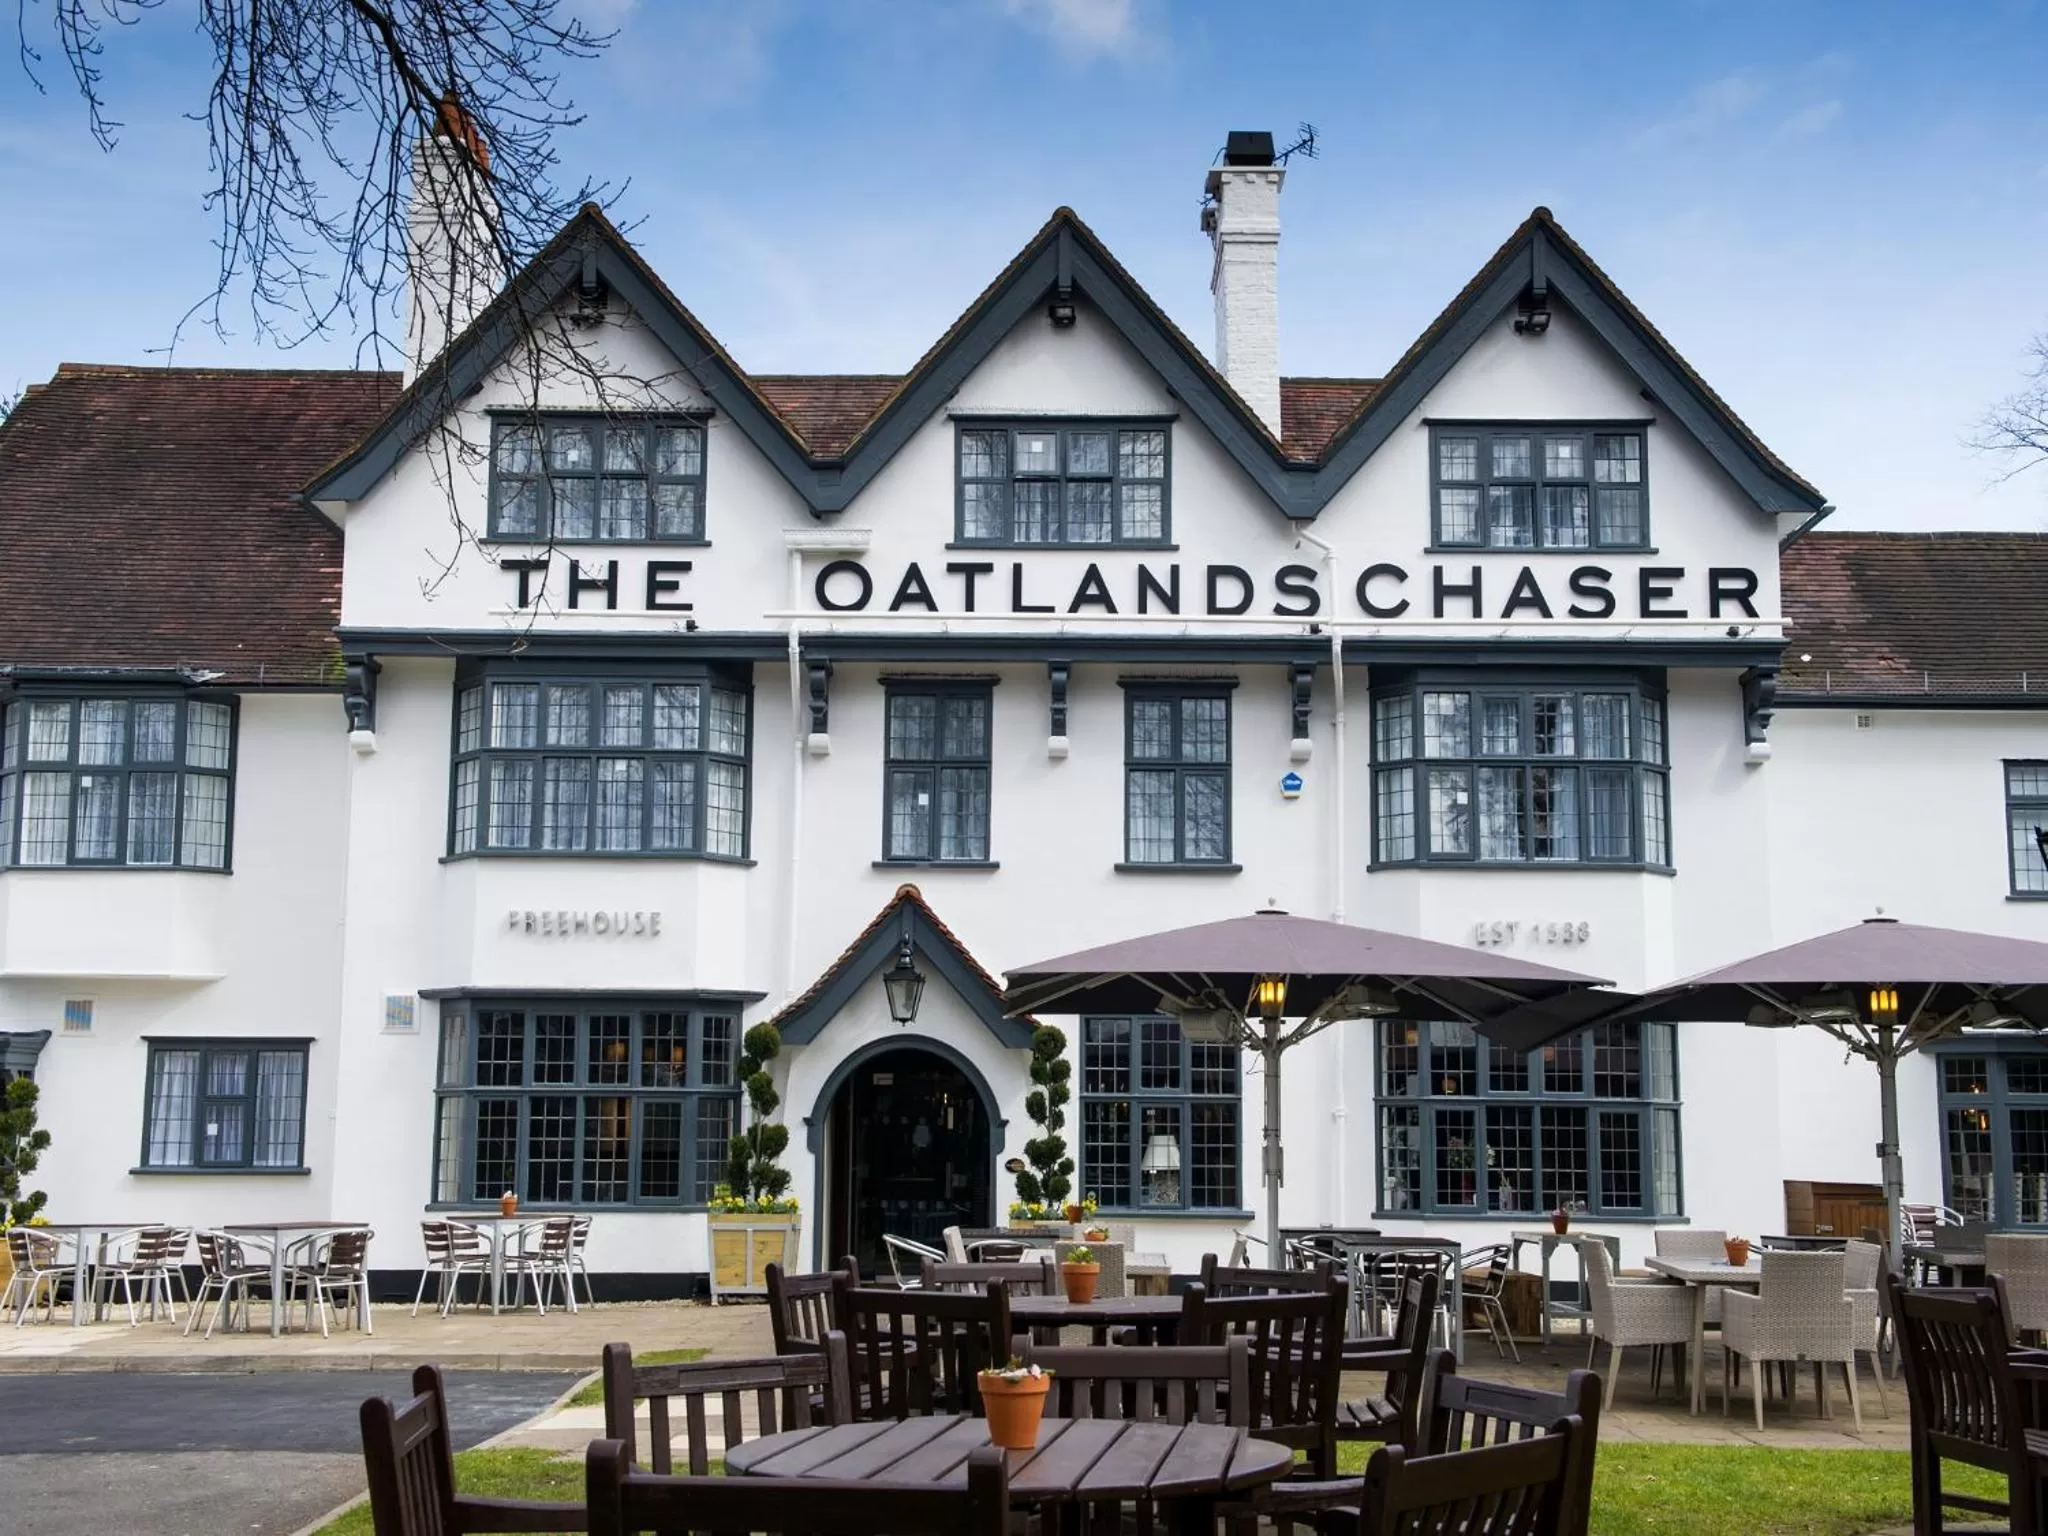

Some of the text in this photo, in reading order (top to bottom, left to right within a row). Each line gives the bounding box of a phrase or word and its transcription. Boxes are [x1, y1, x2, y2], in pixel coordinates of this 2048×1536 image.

[500, 559, 1760, 619] THE OATLANDS CHASER
[508, 910, 662, 937] FREEHOUSE
[1474, 920, 1520, 945] EST
